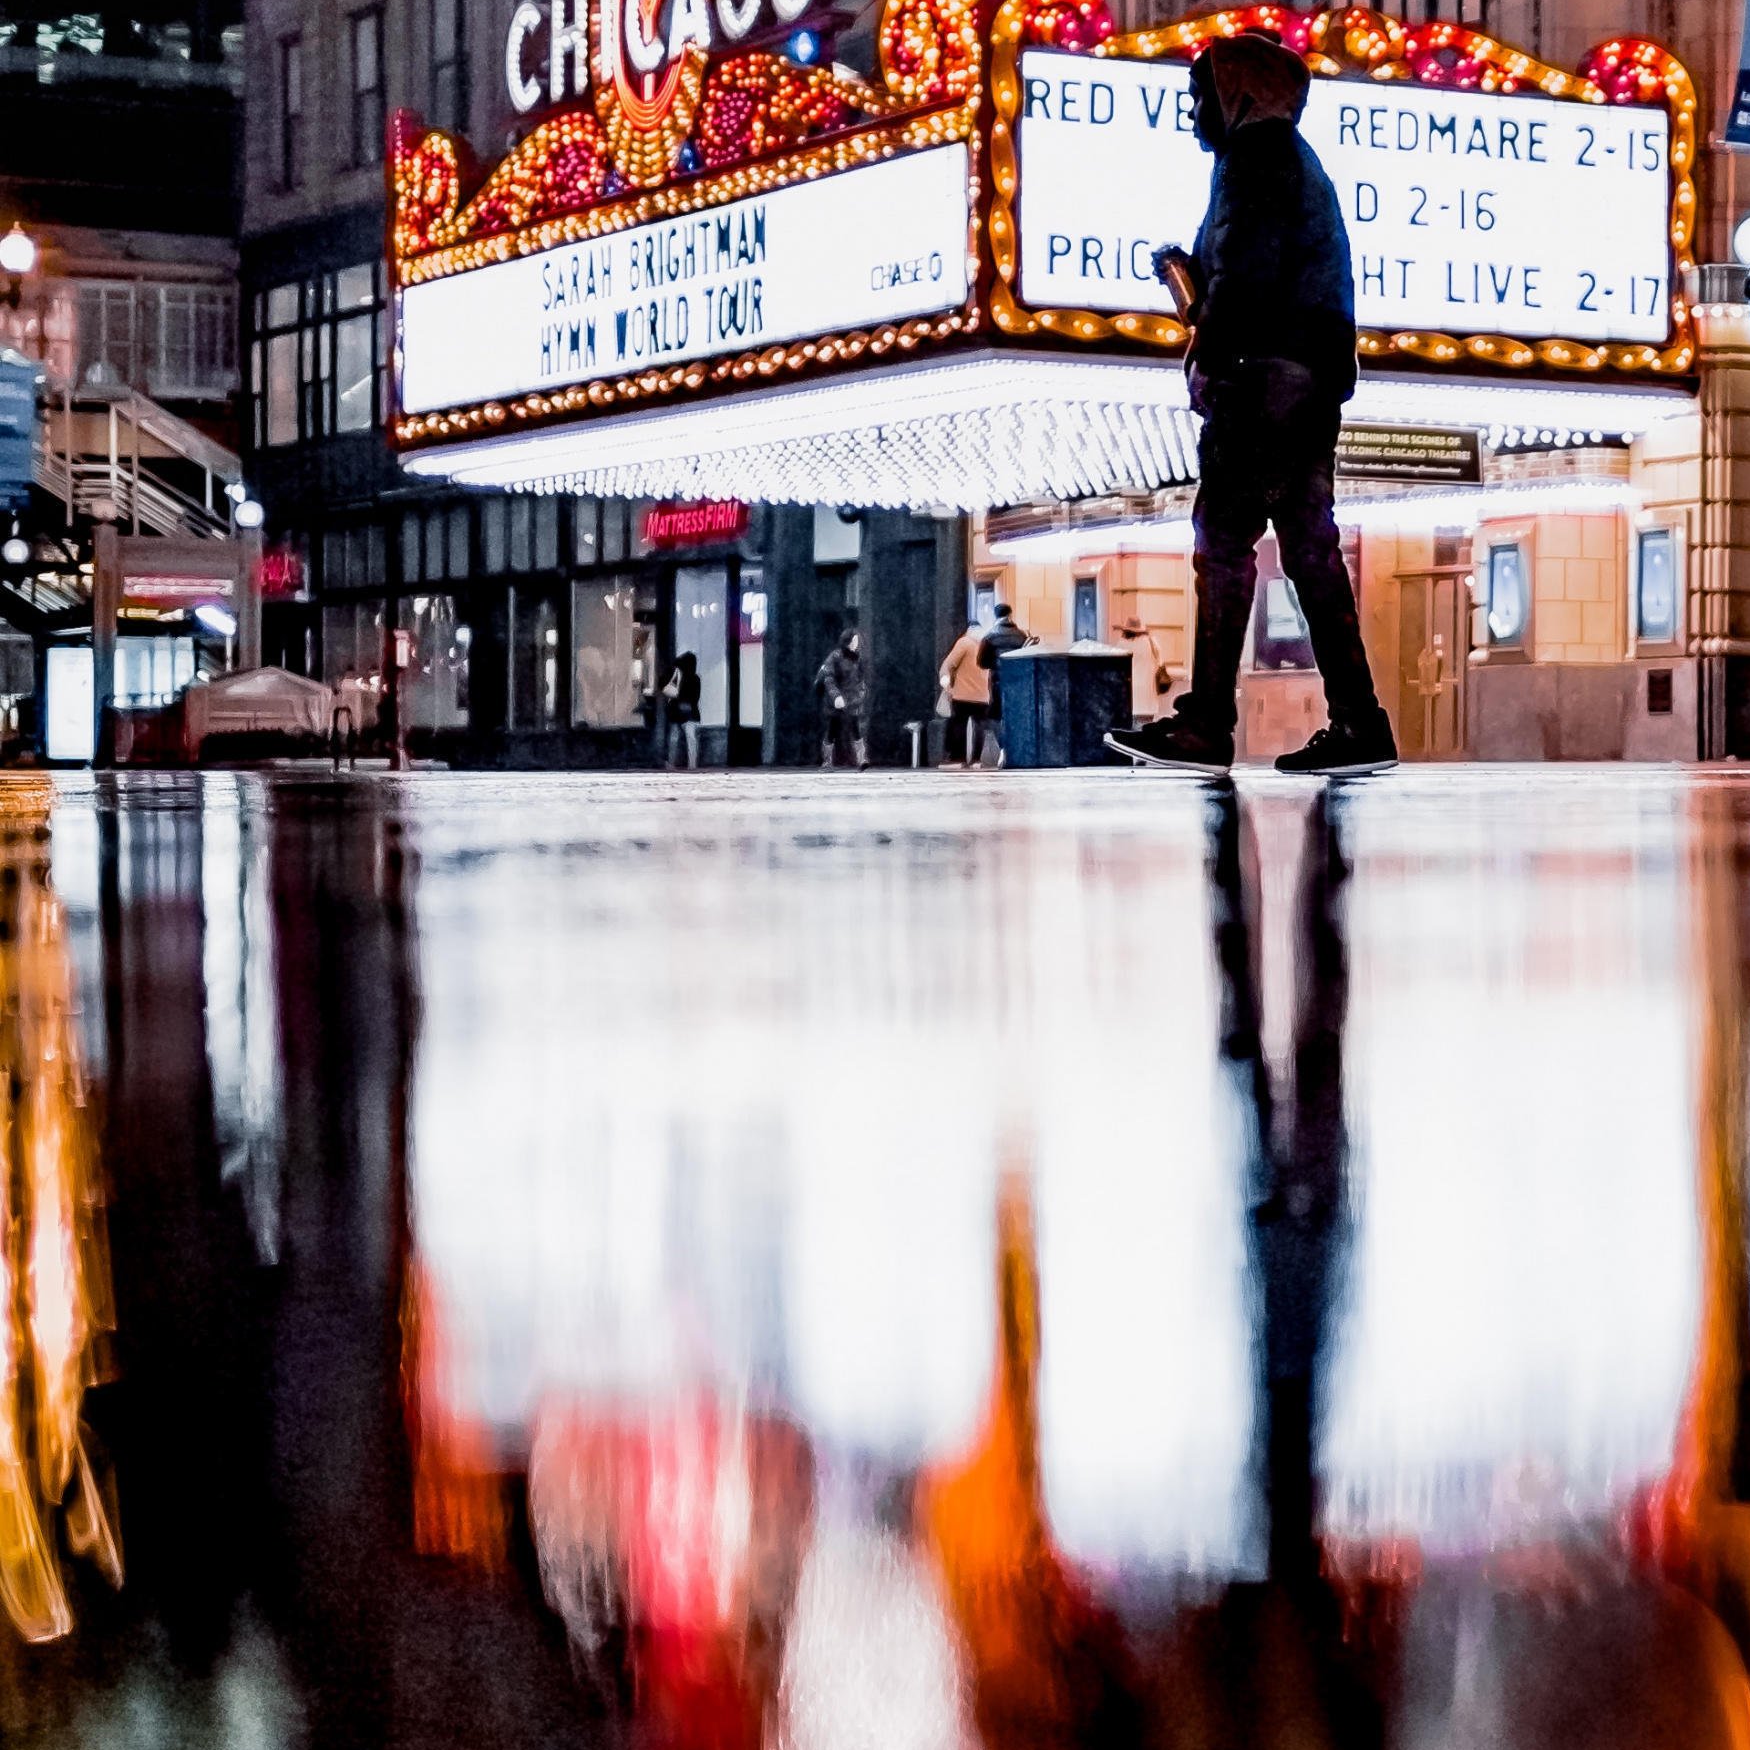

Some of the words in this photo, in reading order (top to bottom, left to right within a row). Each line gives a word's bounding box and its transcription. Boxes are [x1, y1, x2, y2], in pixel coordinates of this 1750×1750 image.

[1024, 78, 1114, 125] RED
[1139, 86, 1195, 132] VE
[1339, 105, 1547, 163] REDMARE
[1576, 126, 1660, 172] 2-15
[1355, 182, 1378, 222] D
[1409, 186, 1498, 231] 2-16
[543, 243, 612, 312] SARAH
[630, 203, 767, 292] BRIGHTMAN
[871, 257, 924, 292] CHASE
[1048, 234, 1175, 282] PRIC
[1361, 254, 1416, 299] HT
[1445, 260, 1542, 309] LIVE
[1576, 271, 1660, 317] 2-17
[541, 315, 597, 377] HYMN
[614, 294, 690, 362] WORLD
[704, 278, 764, 344] TOUR
[1338, 431, 1352, 442] GO
[1354, 432, 1390, 443] BEHIND
[1391, 433, 1410, 444] THE
[1411, 435, 1446, 446] SCENES
[1446, 437, 1462, 447] OF
[1348, 446, 1382, 457] ICONIC
[1383, 447, 1427, 459] CHICAGO
